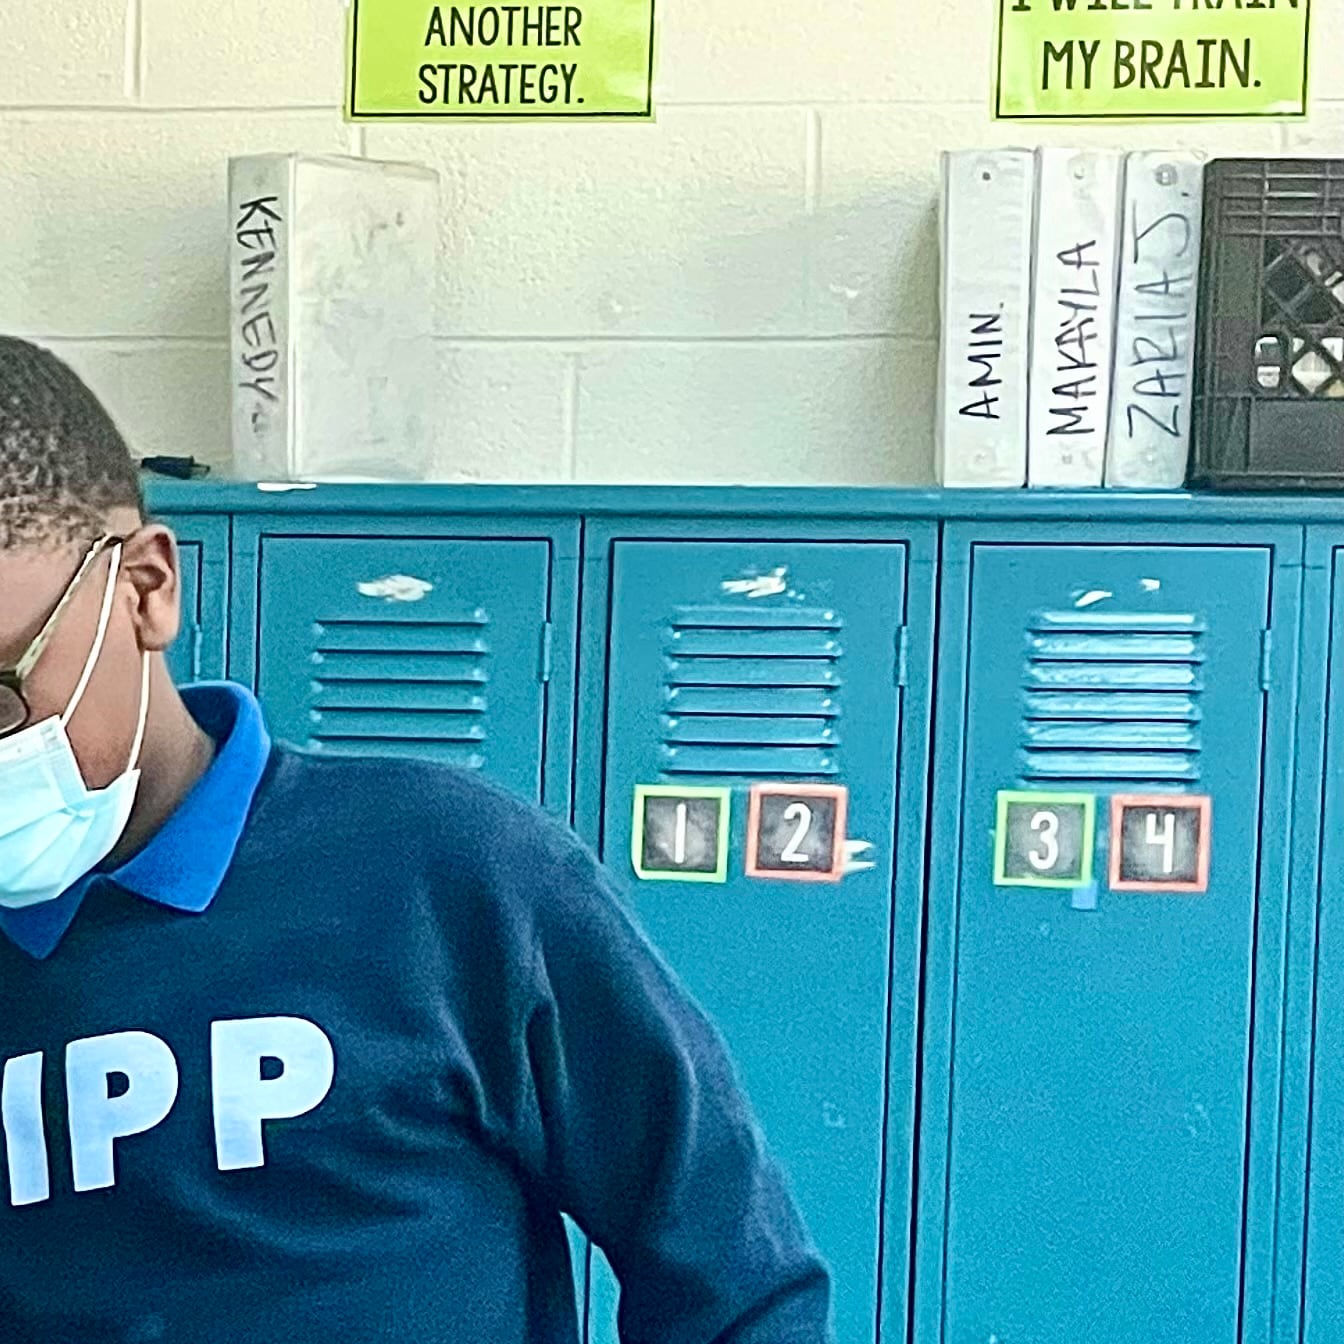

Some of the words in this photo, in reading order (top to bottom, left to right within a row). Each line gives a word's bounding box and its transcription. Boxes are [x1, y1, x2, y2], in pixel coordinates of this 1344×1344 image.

[424, 6, 583, 47] ANOTHER
[418, 63, 585, 105] STRATEGY.
[1041, 40, 1101, 90] MY
[1113, 38, 1262, 89] BRAIN.
[236, 196, 283, 403] KENNEDY
[1046, 238, 1100, 436] MAKAYLA
[1125, 270, 1193, 439] ZARIA
[673, 803, 686, 864] 1
[779, 801, 814, 863] 2
[1028, 810, 1060, 870] 3
[1144, 812, 1176, 873] 4
